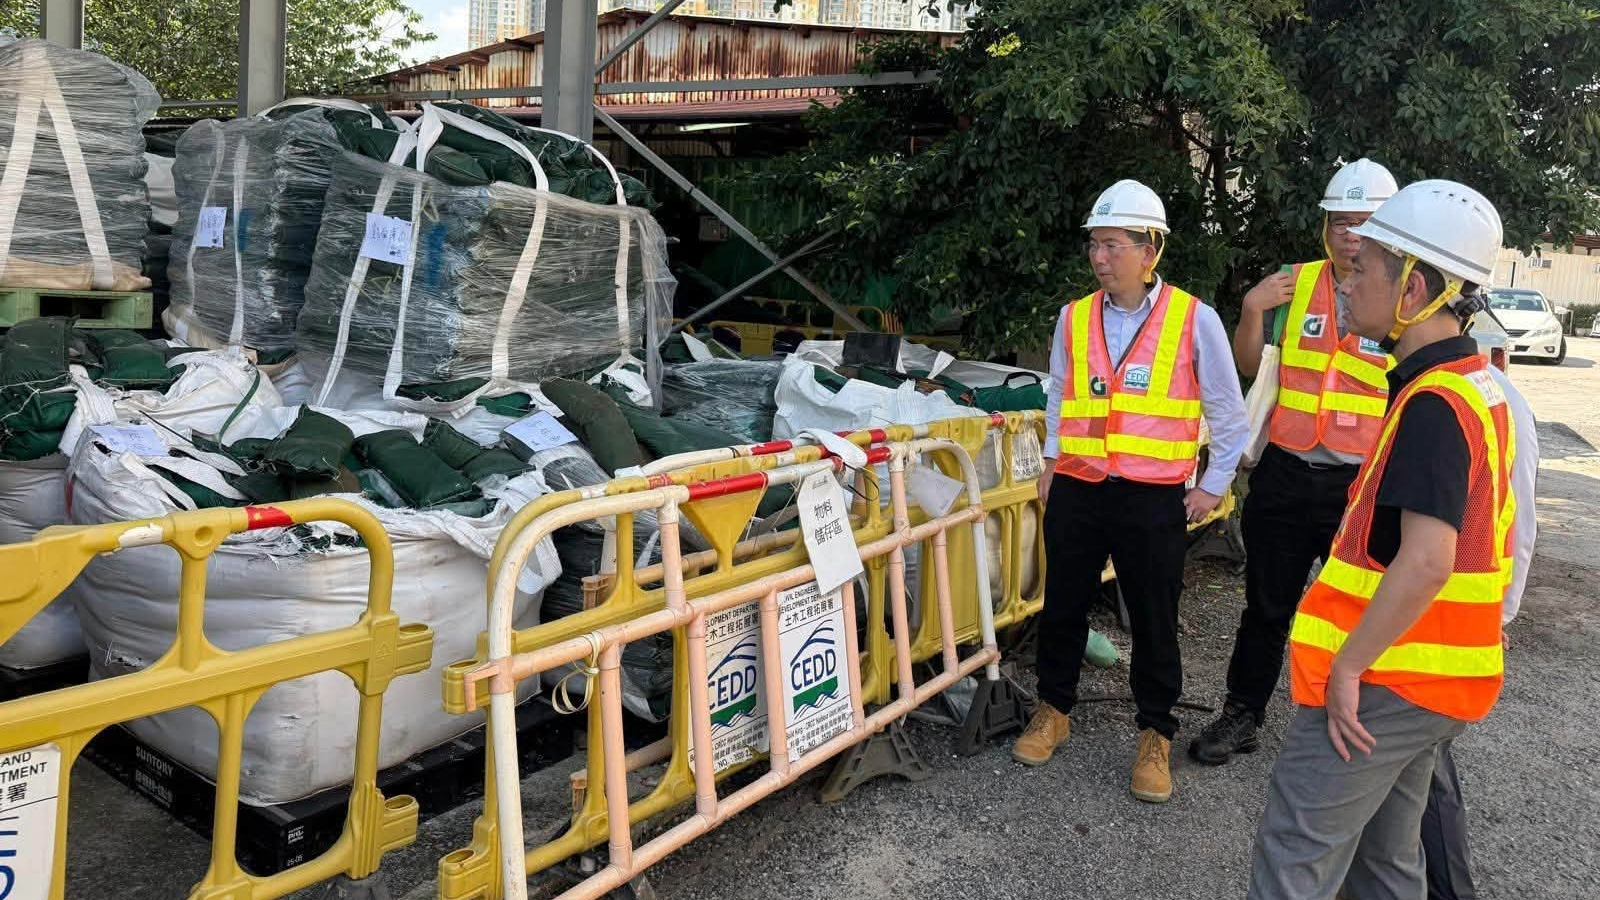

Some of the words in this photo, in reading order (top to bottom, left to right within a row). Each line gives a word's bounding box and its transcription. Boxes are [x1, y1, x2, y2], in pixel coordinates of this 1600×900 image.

[814, 499, 833, 520] 物料
[814, 518, 843, 546] 儲存區
[795, 585, 818, 598] ENGINEER
[732, 602, 760, 618] DEPARTME
[780, 597, 810, 613] EVELOPMENT
[785, 598, 834, 627] 土木工程拓展署
[791, 649, 837, 691] CEDD
[1, 752, 31, 767] AND
[136, 746, 173, 777] SUNTORY
[0, 762, 47, 784] TMENT
